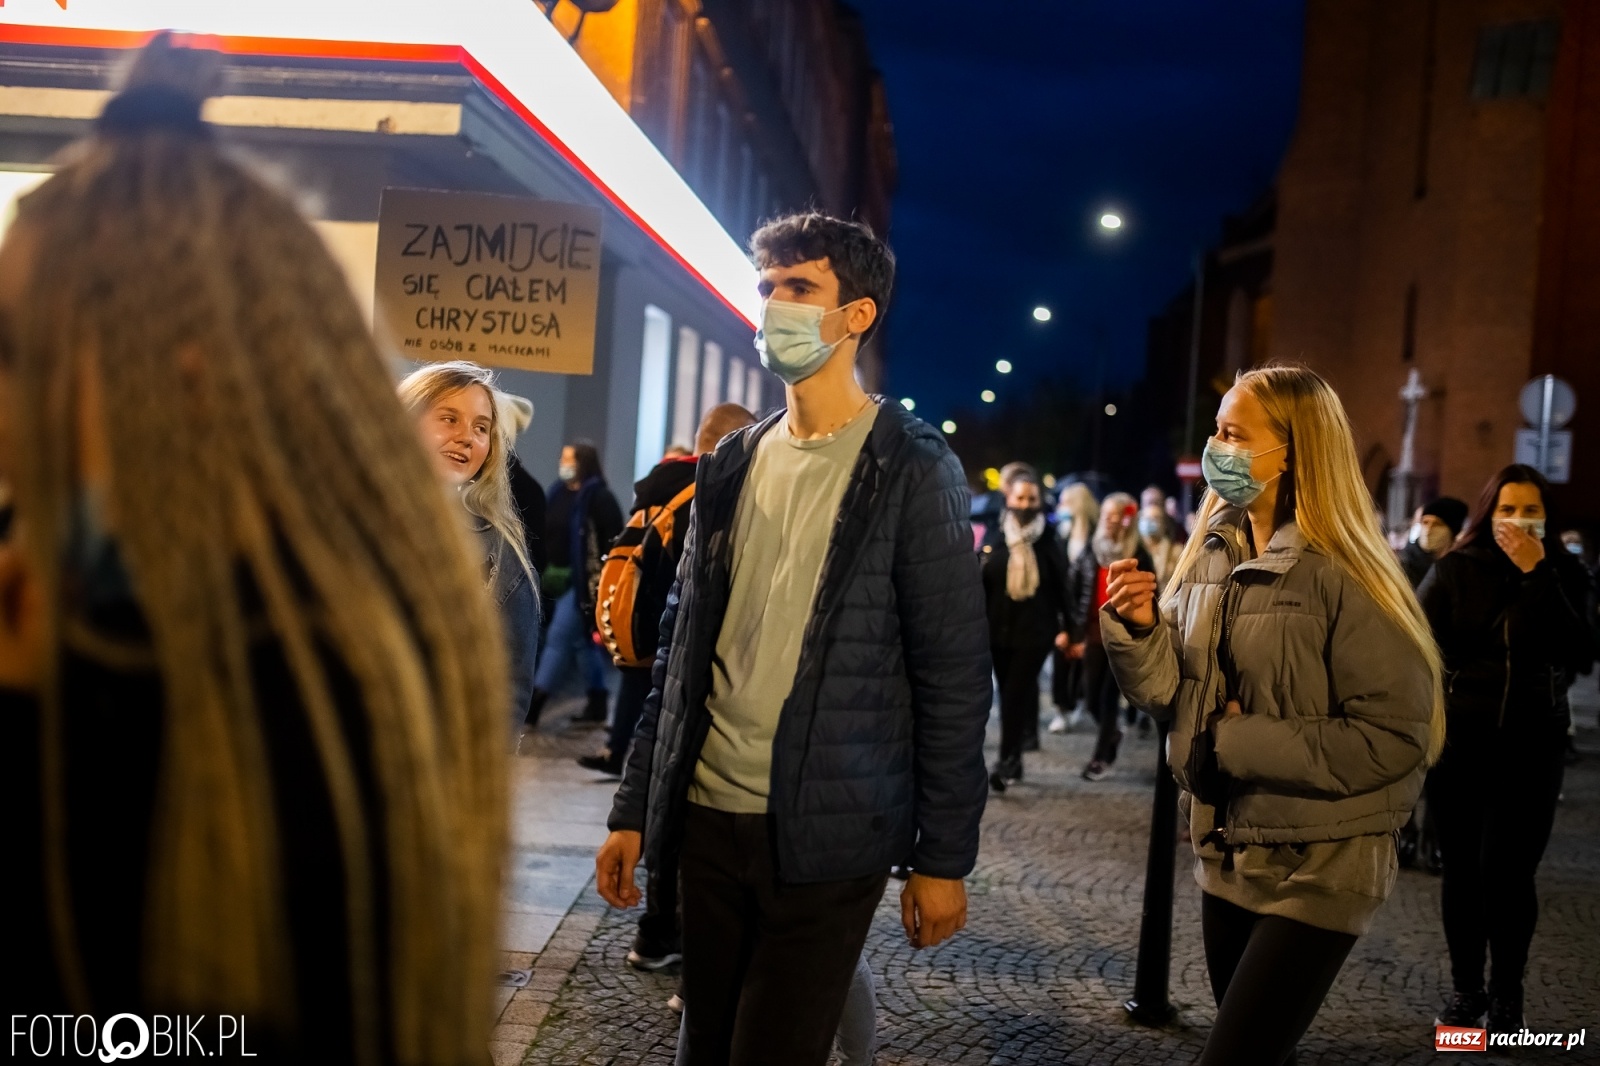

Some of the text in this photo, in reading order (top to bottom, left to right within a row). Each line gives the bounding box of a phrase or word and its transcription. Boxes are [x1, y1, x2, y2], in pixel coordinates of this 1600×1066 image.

[401, 222, 597, 273] ZAJMIJCIE
[402, 273, 568, 305] SIĘ CIAŁEM
[415, 306, 562, 339] CHRYSTUSA
[404, 337, 551, 358] NIE OSÓB Z MACICAMI
